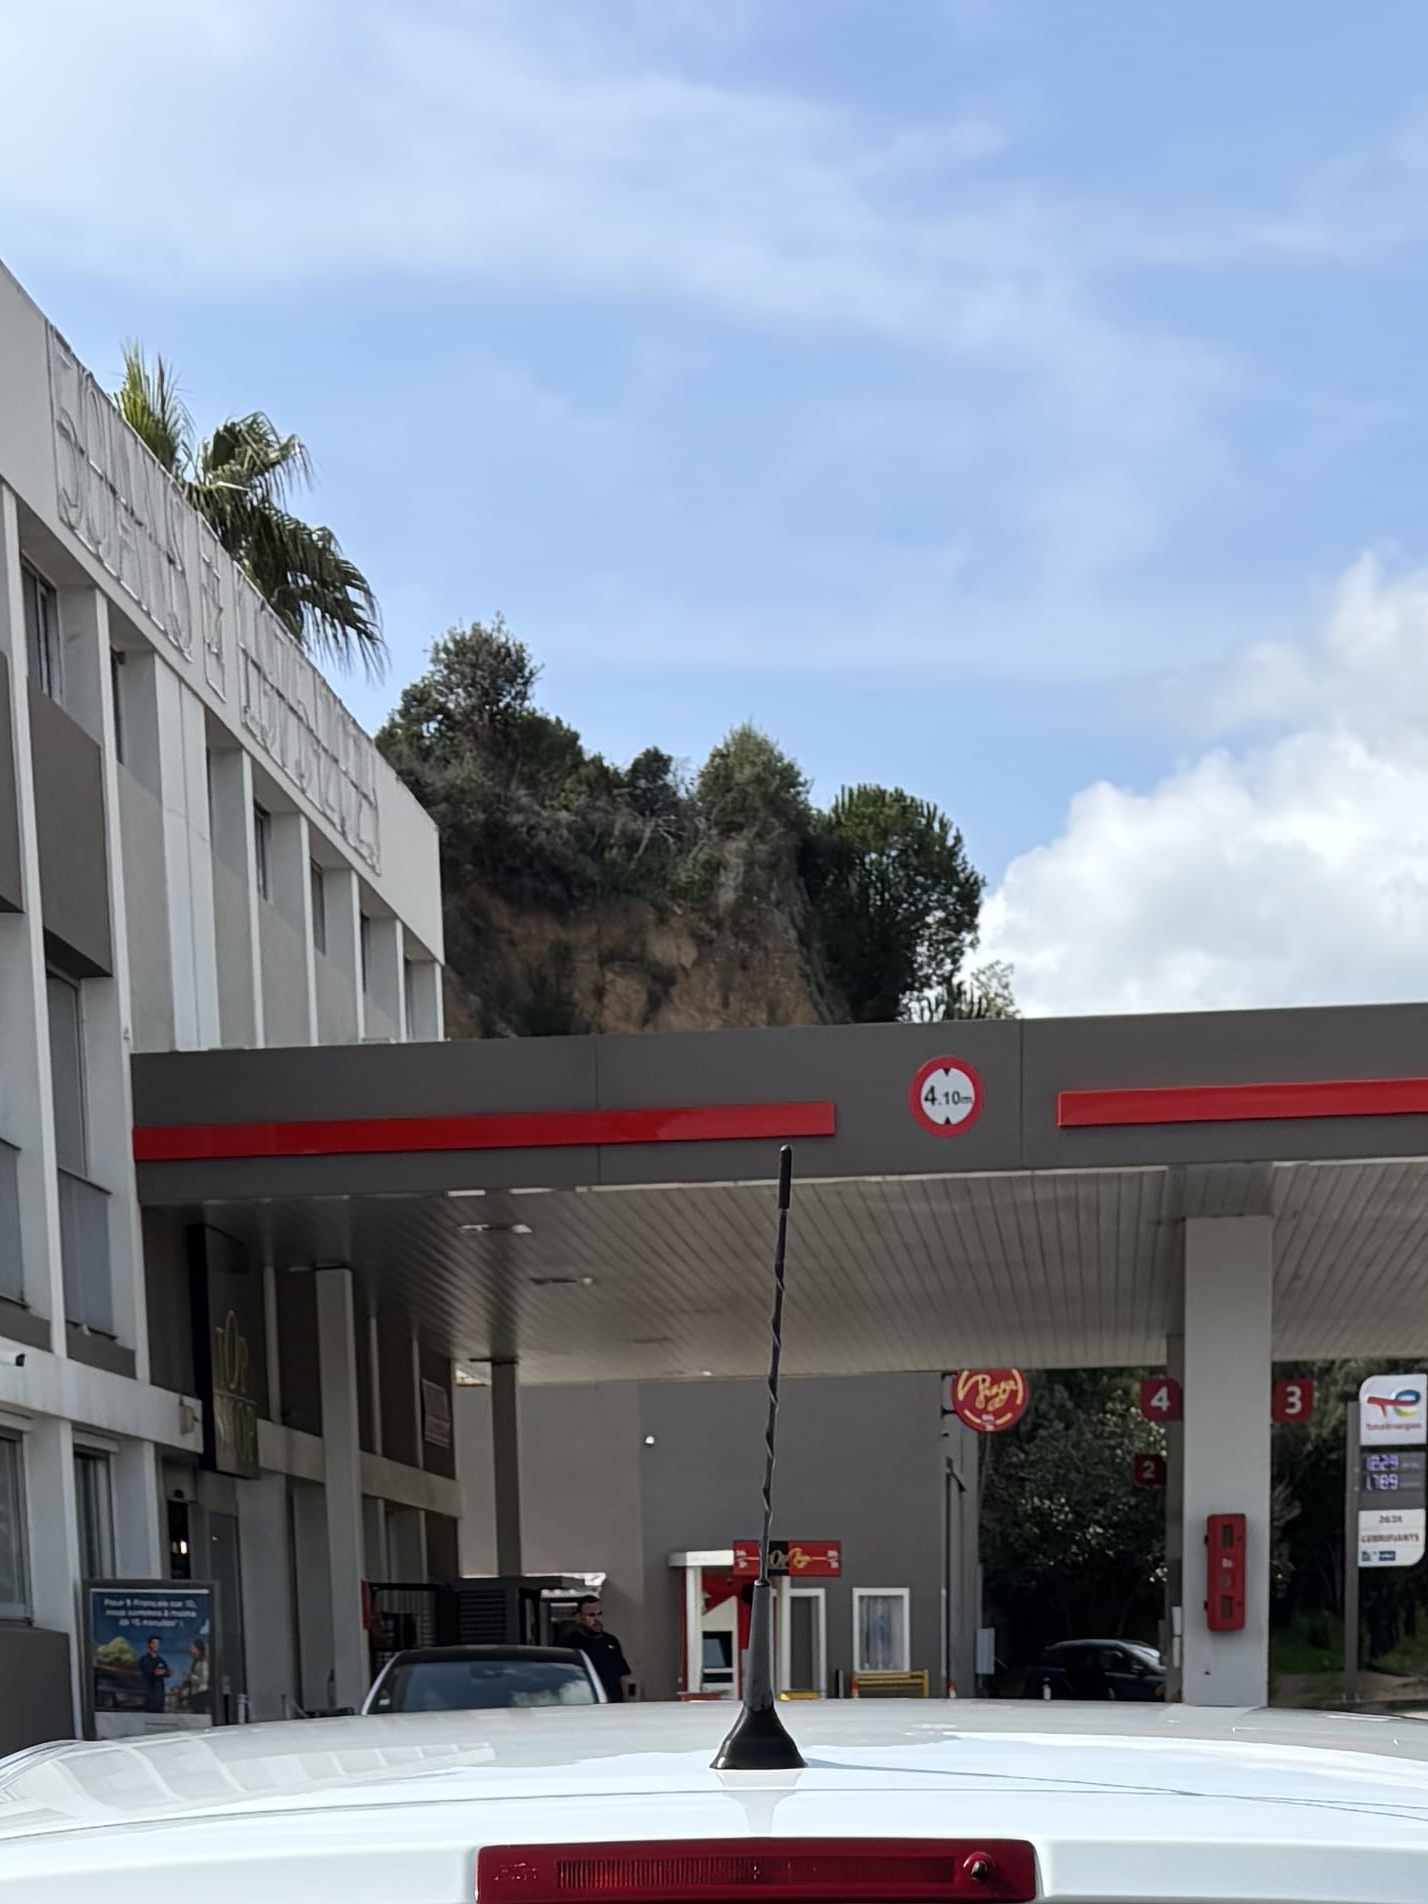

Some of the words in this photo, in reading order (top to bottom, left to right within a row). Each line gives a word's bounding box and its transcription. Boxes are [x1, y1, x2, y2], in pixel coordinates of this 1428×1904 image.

[1150, 1387, 1171, 1412] 4
[1285, 1385, 1303, 1415] 3
[1142, 1460, 1156, 1479] 2
